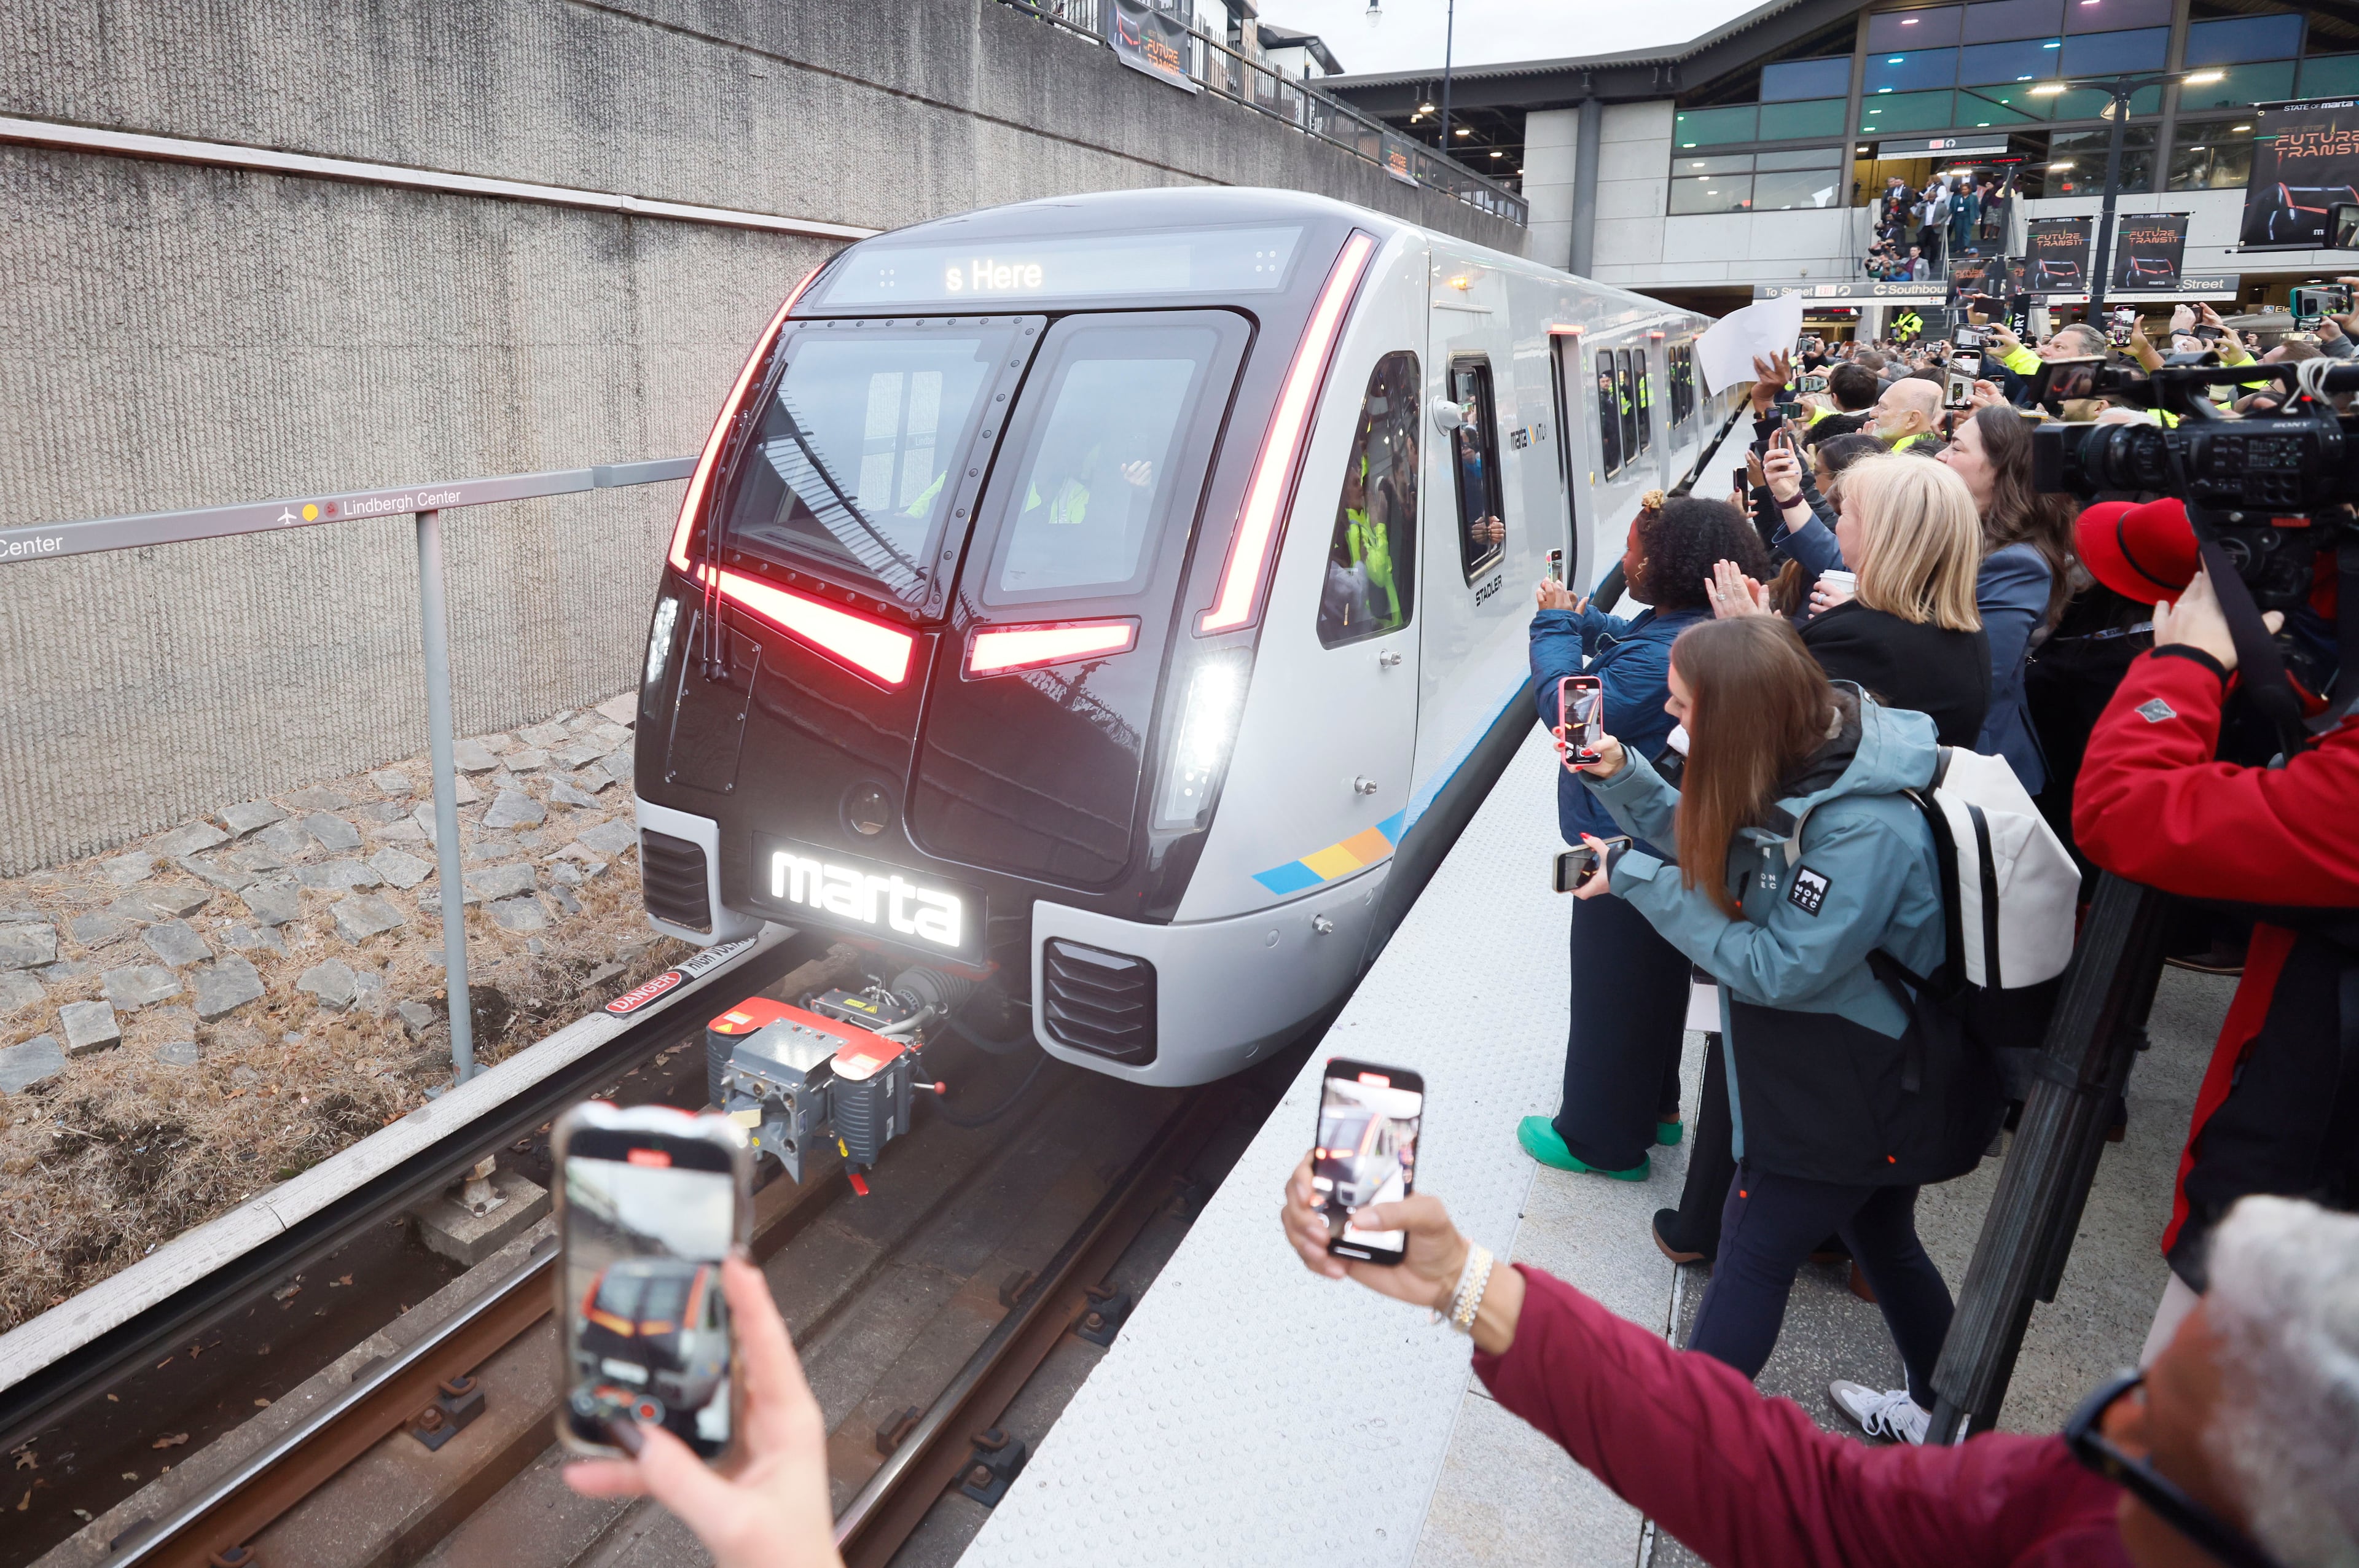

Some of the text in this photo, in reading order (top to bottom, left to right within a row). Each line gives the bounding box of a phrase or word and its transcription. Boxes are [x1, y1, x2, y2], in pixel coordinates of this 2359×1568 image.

[1148, 39, 1179, 64] FUTURE
[1148, 53, 1182, 77] TRANSIT
[2321, 101, 2354, 109] marta
[972, 259, 1042, 291] Here
[2182, 279, 2224, 289] Street
[1764, 286, 1813, 297] To Stet
[2013, 313, 2025, 343] ORY
[1511, 427, 1527, 451] marta
[343, 490, 461, 516] Lindbergh Center
[1476, 574, 1503, 607] STADLER
[772, 851, 961, 948] marta
[611, 975, 677, 1010] DANGER
[681, 953, 716, 971] HIGH
